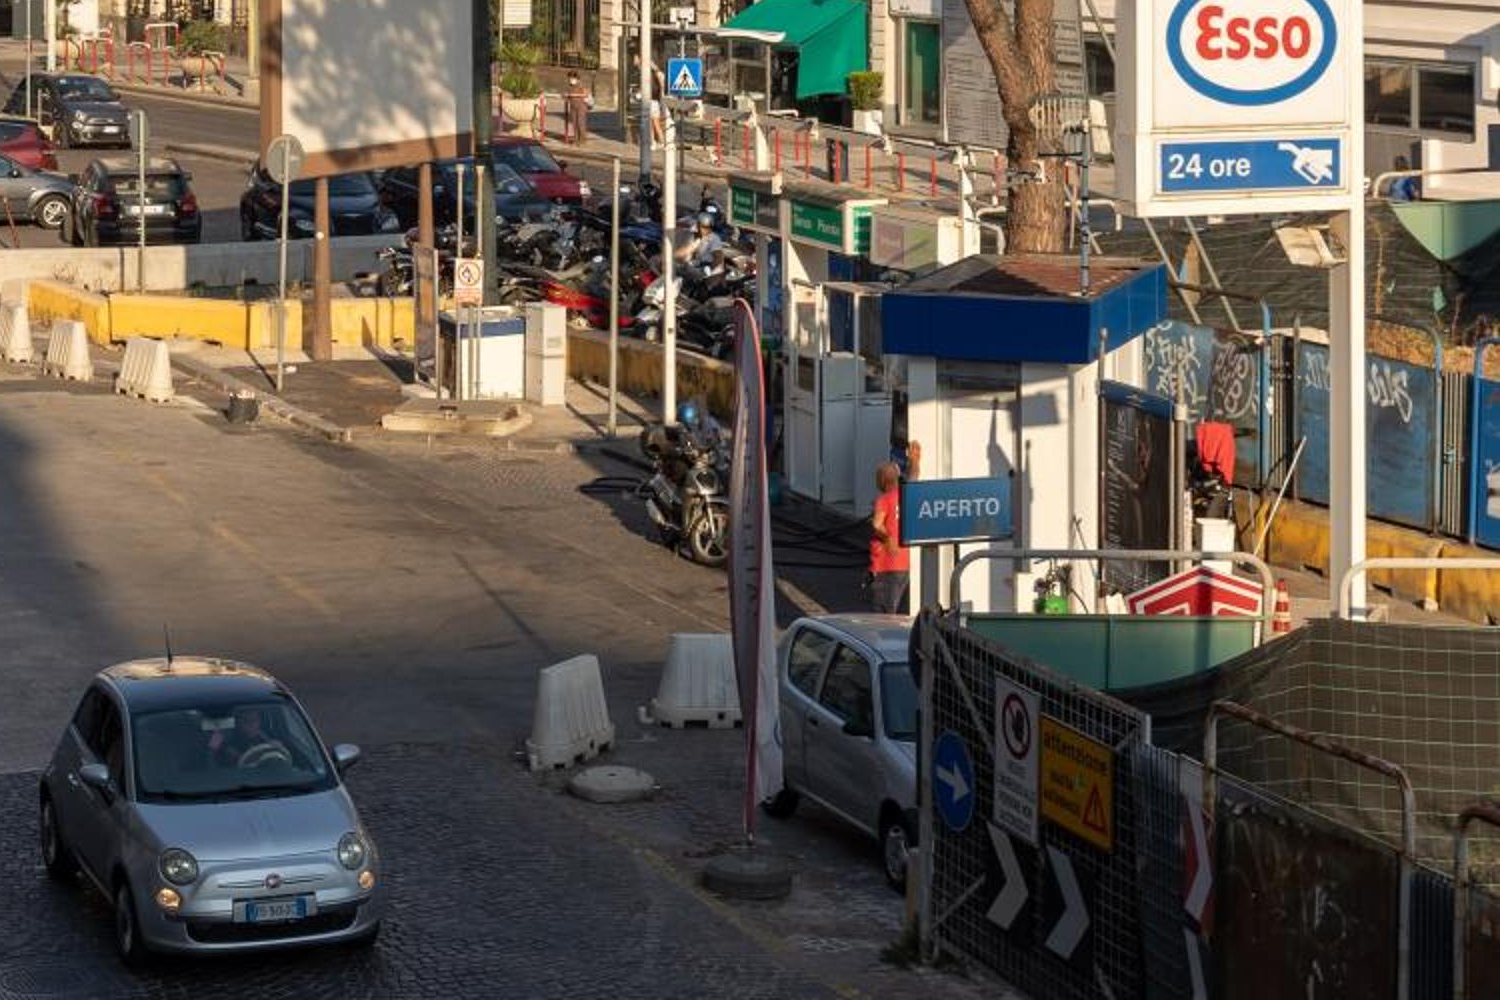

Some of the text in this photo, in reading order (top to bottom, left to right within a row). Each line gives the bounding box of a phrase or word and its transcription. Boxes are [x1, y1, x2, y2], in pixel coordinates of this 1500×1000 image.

[1196, 4, 1312, 61] Esso
[1167, 153, 1252, 179] 24 ore
[918, 497, 1000, 519] APERTO
[1043, 730, 1108, 777] attenzione
